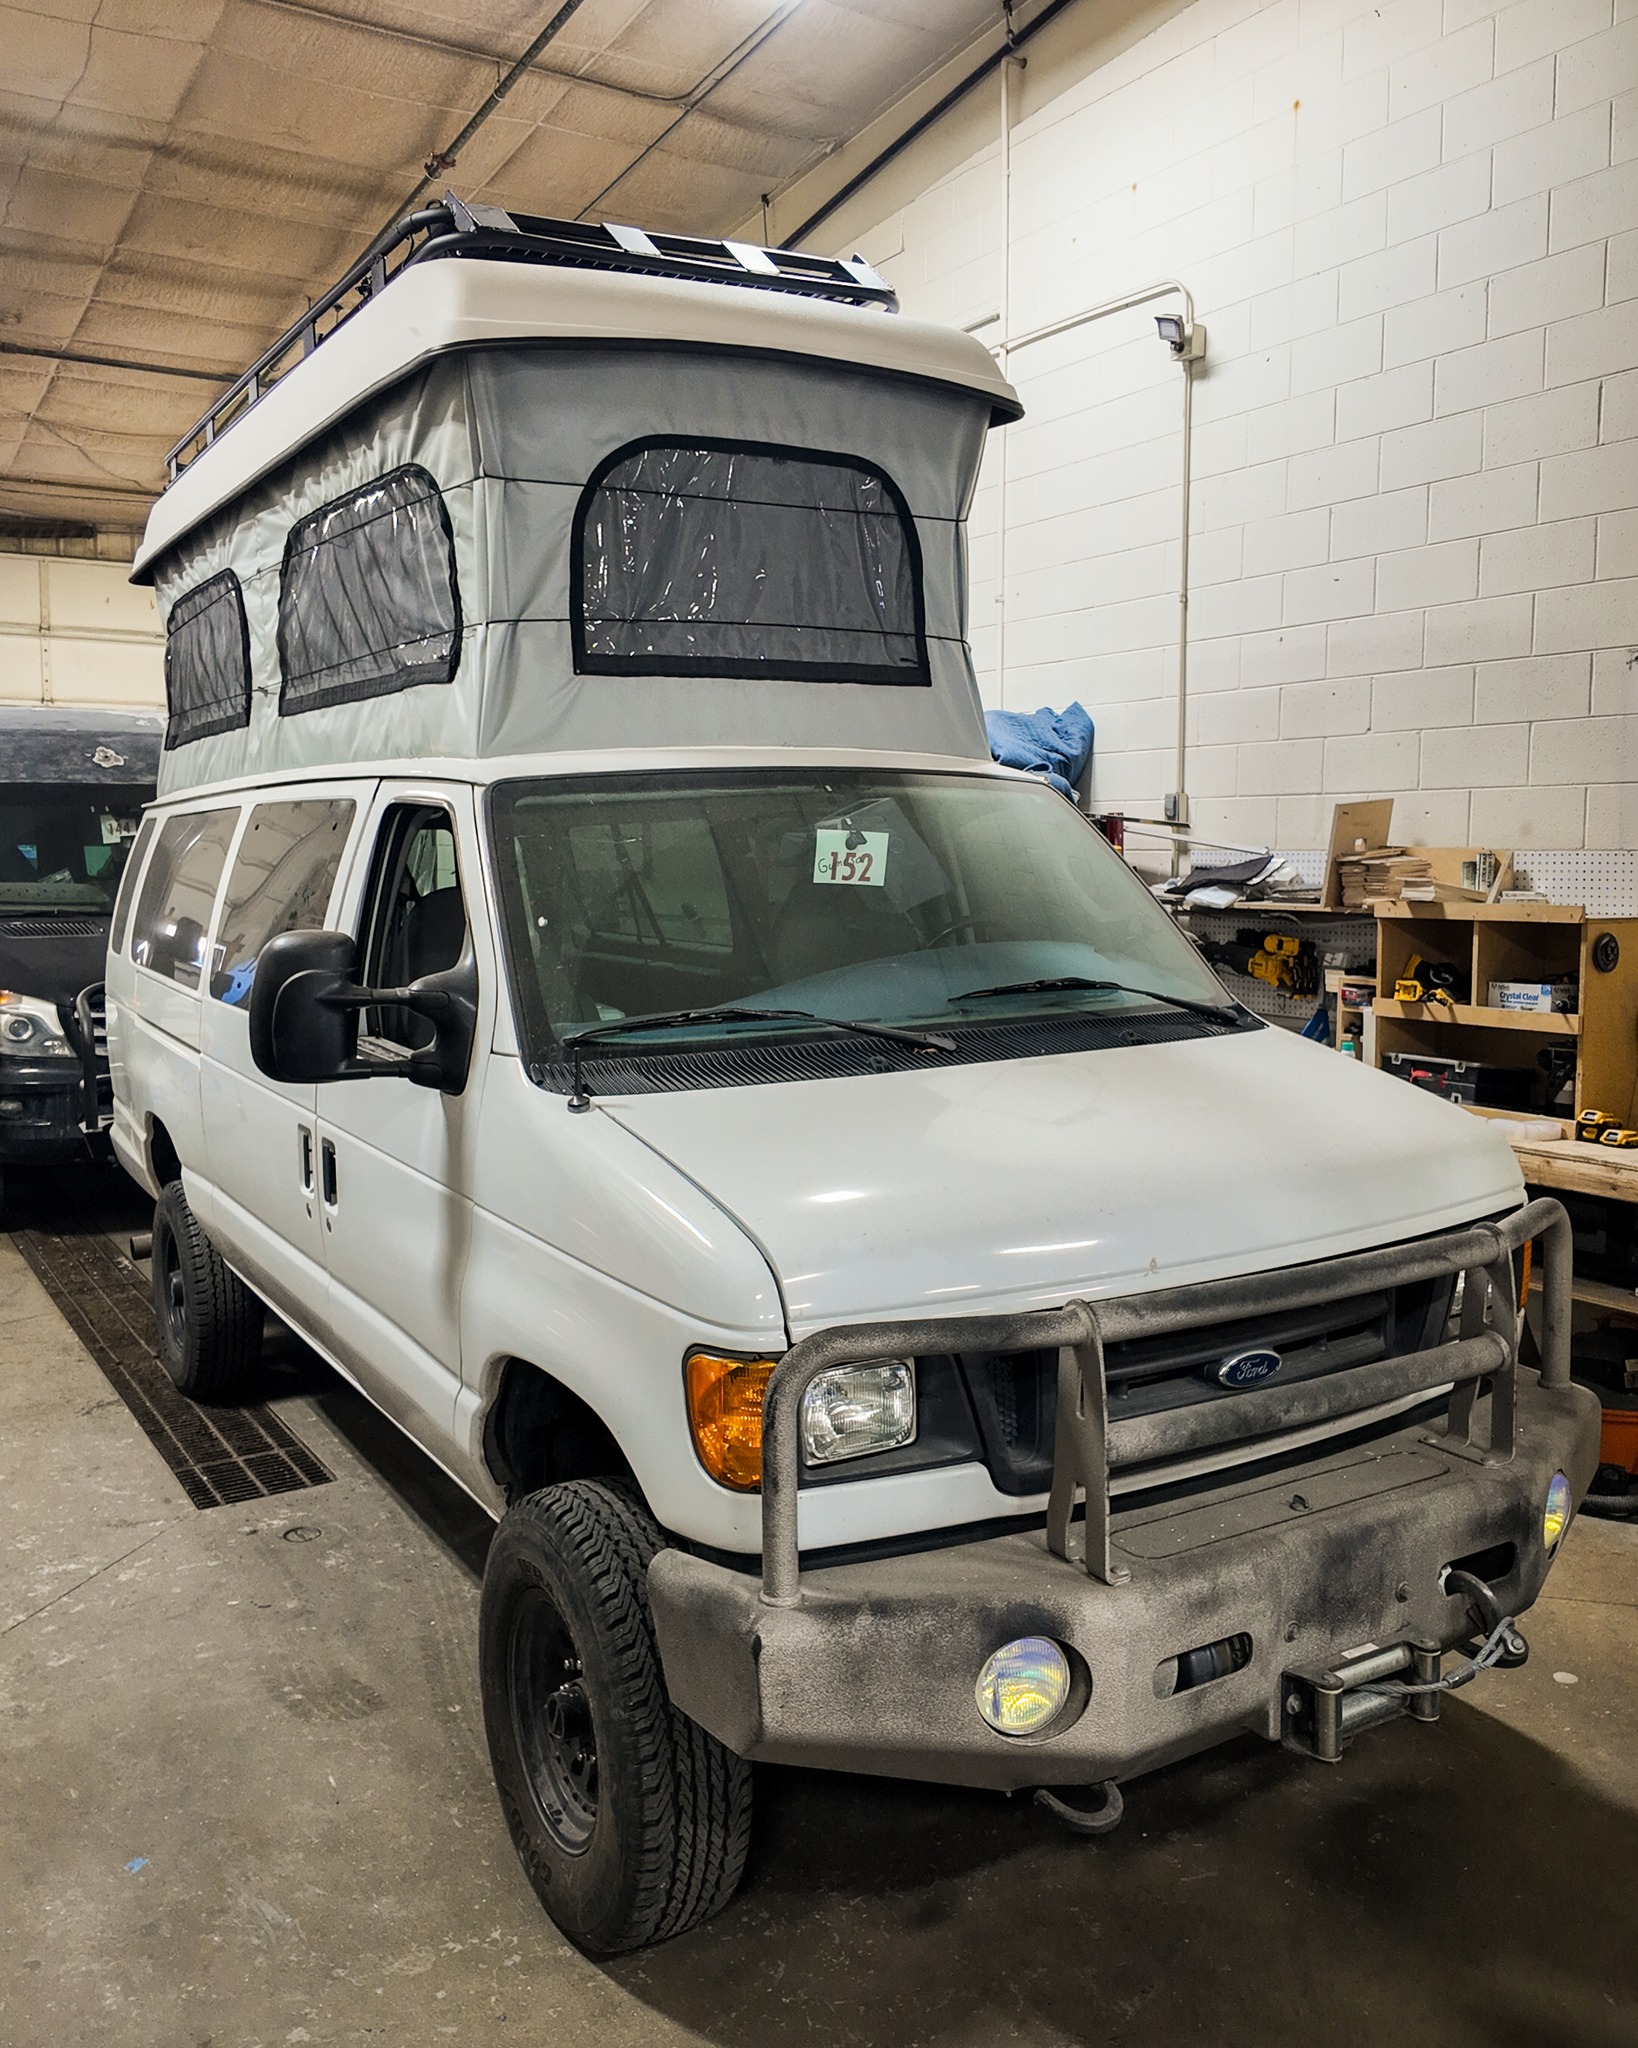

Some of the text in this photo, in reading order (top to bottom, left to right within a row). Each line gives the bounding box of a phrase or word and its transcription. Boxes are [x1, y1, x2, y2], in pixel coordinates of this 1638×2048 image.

[108, 821, 131, 836] 144
[830, 851, 874, 881] 152
[1499, 991, 1540, 1002] Crystal Clear
[1236, 1358, 1269, 1380] Ford
